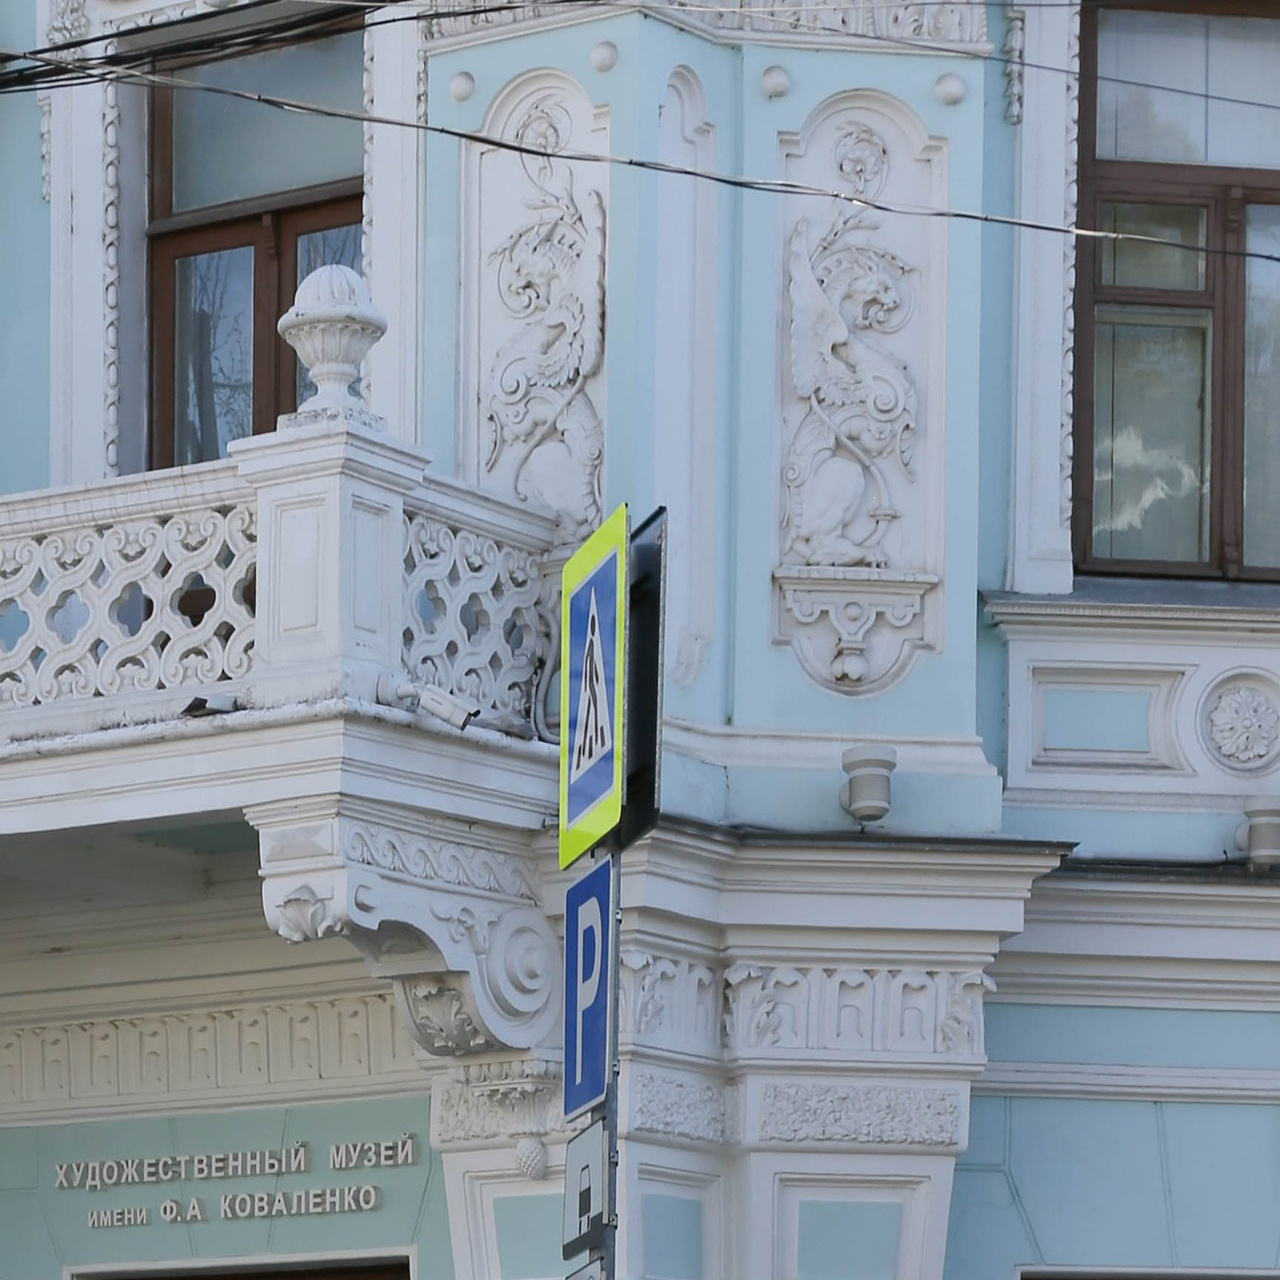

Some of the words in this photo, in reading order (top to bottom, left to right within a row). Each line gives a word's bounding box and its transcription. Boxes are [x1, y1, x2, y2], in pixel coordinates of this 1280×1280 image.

[575, 896, 602, 1086] P
[55, 1140, 309, 1190] ХУДОЖЕСТВЕННЫЙ
[329, 1132, 418, 1170] МУЗЕЙ
[88, 1206, 147, 1228] ИМЕНИ
[220, 1184, 380, 1219] КОВАЛЕНКО
